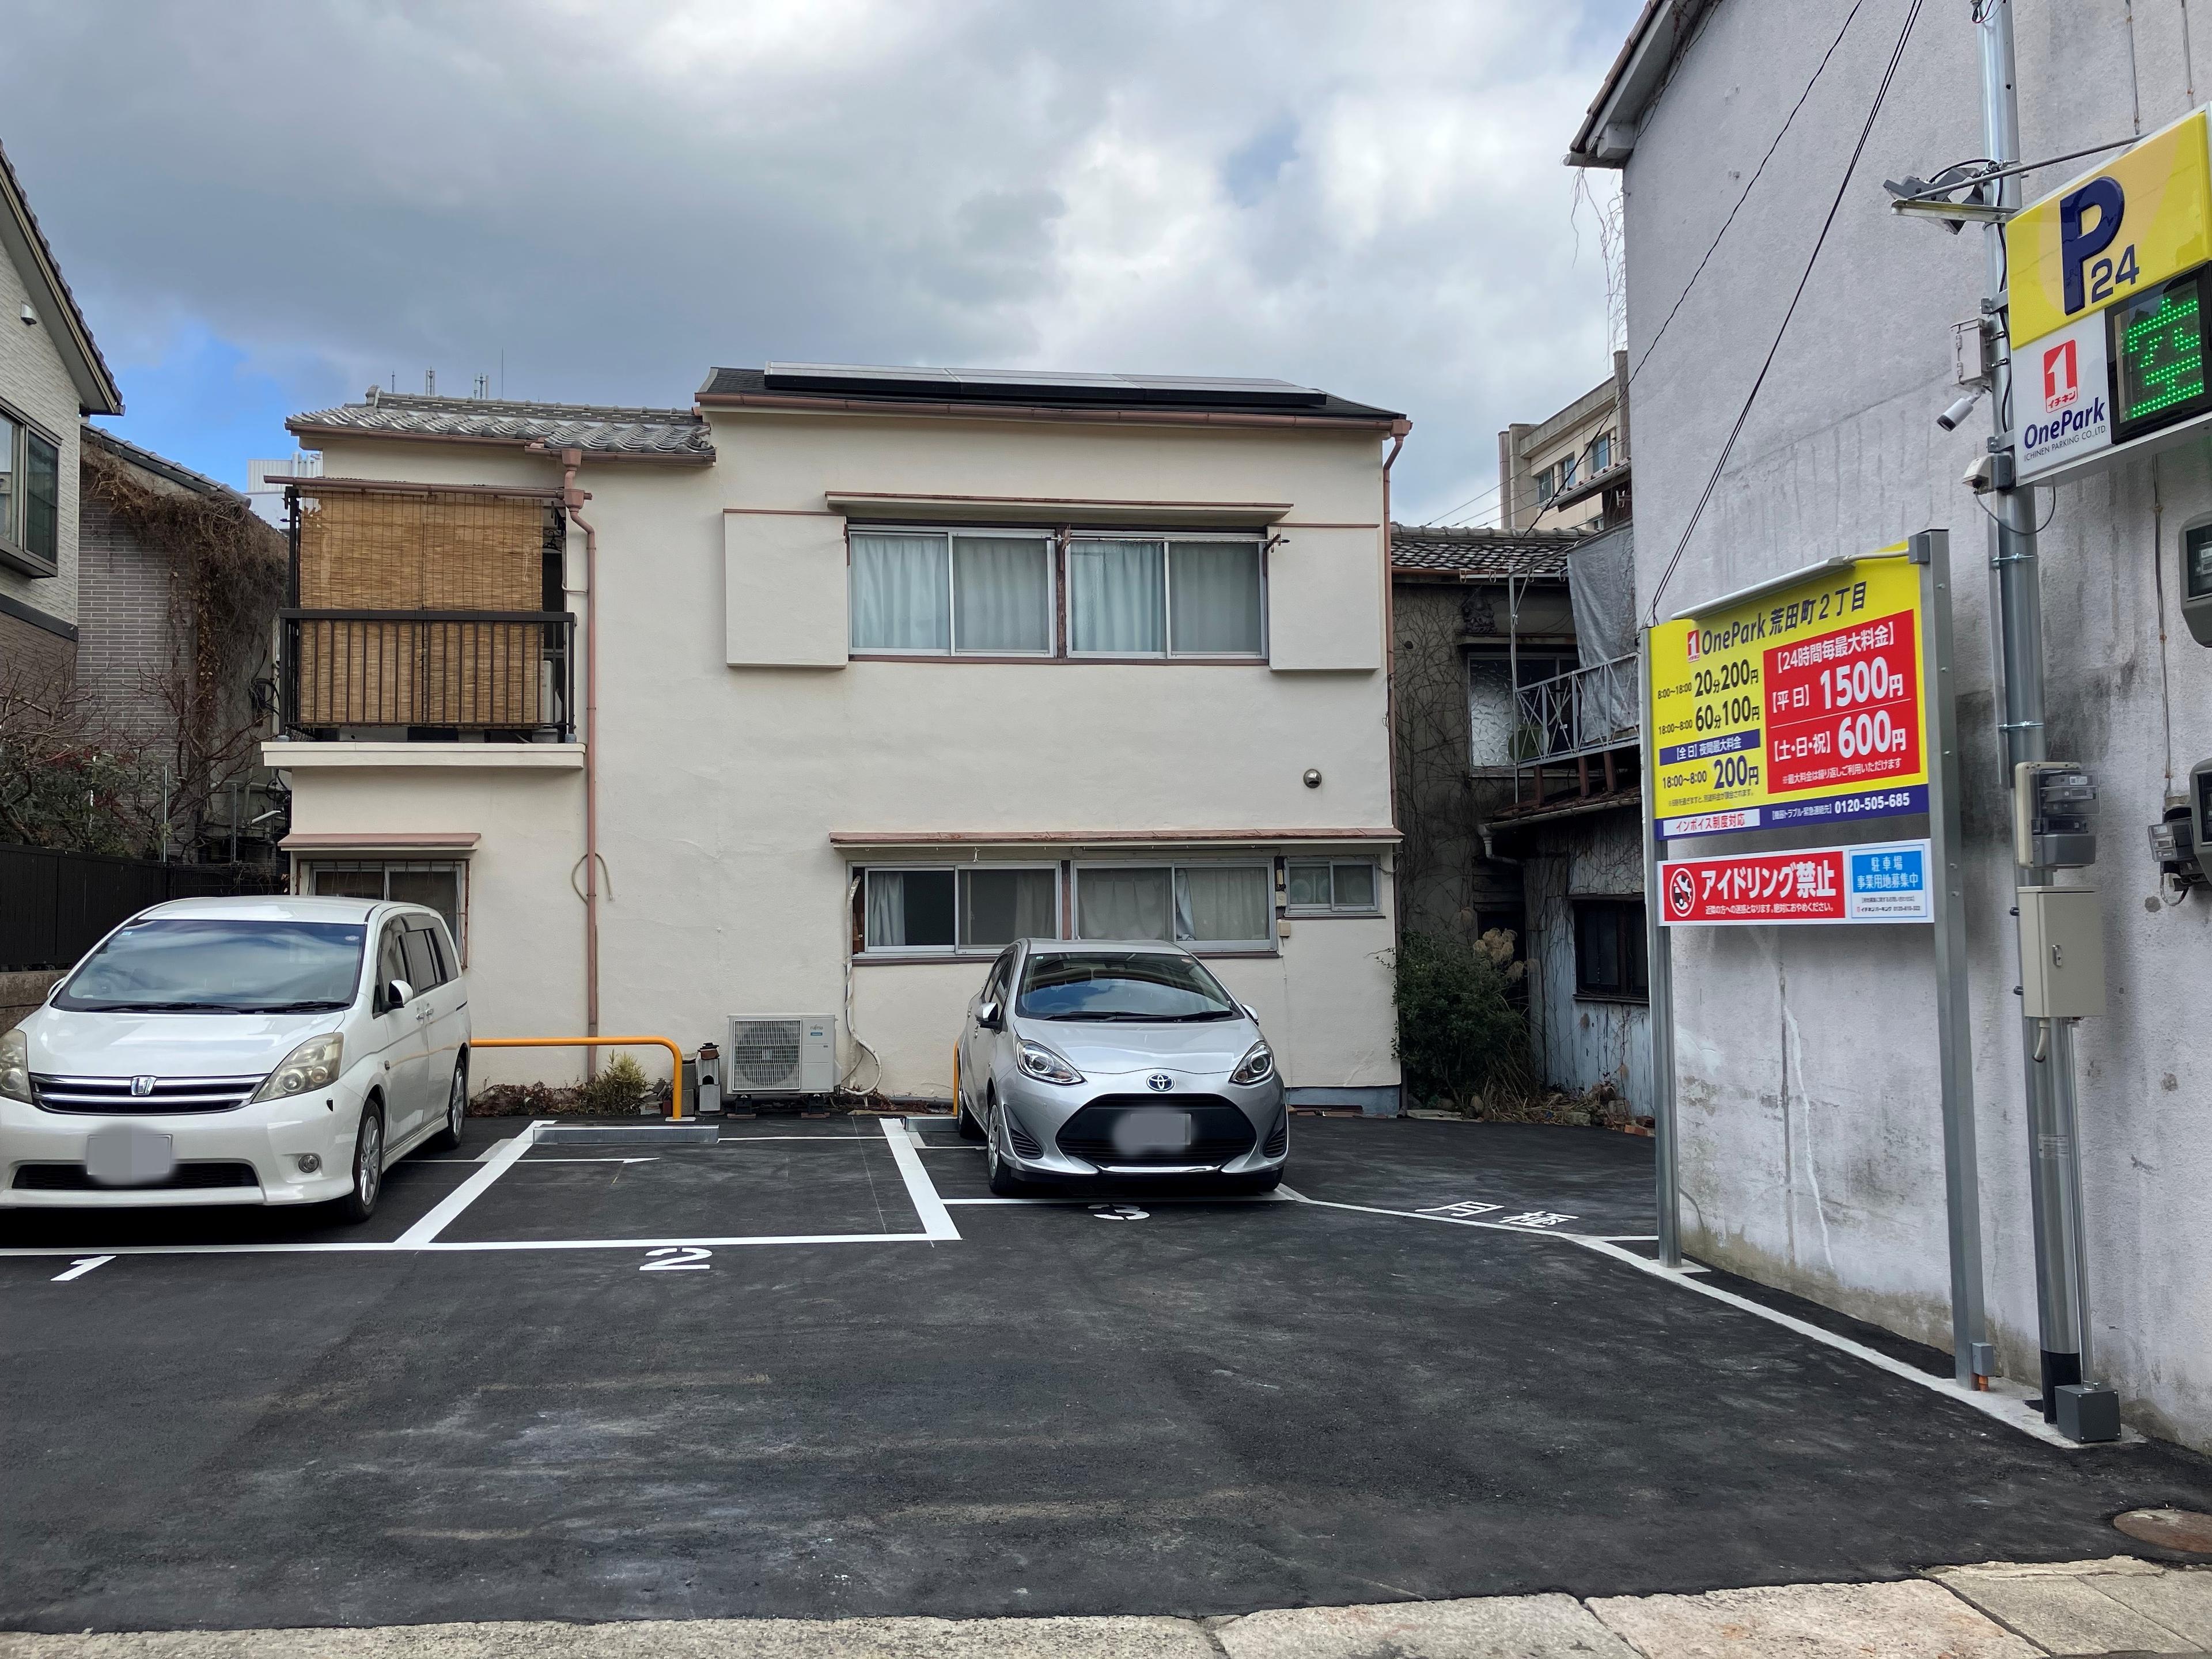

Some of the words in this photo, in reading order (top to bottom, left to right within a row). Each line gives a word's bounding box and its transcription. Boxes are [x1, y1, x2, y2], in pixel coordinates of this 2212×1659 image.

[2059, 175, 2126, 316] P
[2090, 244, 2140, 304] 24
[2122, 297, 2203, 421] 空
[2048, 390, 2075, 408] イチネン
[2024, 396, 2105, 449] OnePark
[2024, 446, 2050, 461] ICHINEN
[2051, 434, 2080, 451] PARKING
[1702, 612, 1766, 655] OnePark
[1769, 581, 1867, 637] 荒田町2丁目
[1820, 656, 1904, 710] 1500円
[1838, 710, 1907, 759] 600円
[1713, 755, 1759, 790] 200円
[1834, 792, 1911, 814] 0120-505-685
[1676, 813, 1745, 833] インボイス制度対応
[1871, 855, 1903, 872] 駐車場
[1700, 859, 1837, 901] アイドリング禁止
[1857, 872, 1919, 890] 事業用地募集中
[1088, 1203, 1150, 1221] 3
[50, 1255, 117, 1282] 1
[638, 1247, 713, 1271] 2
